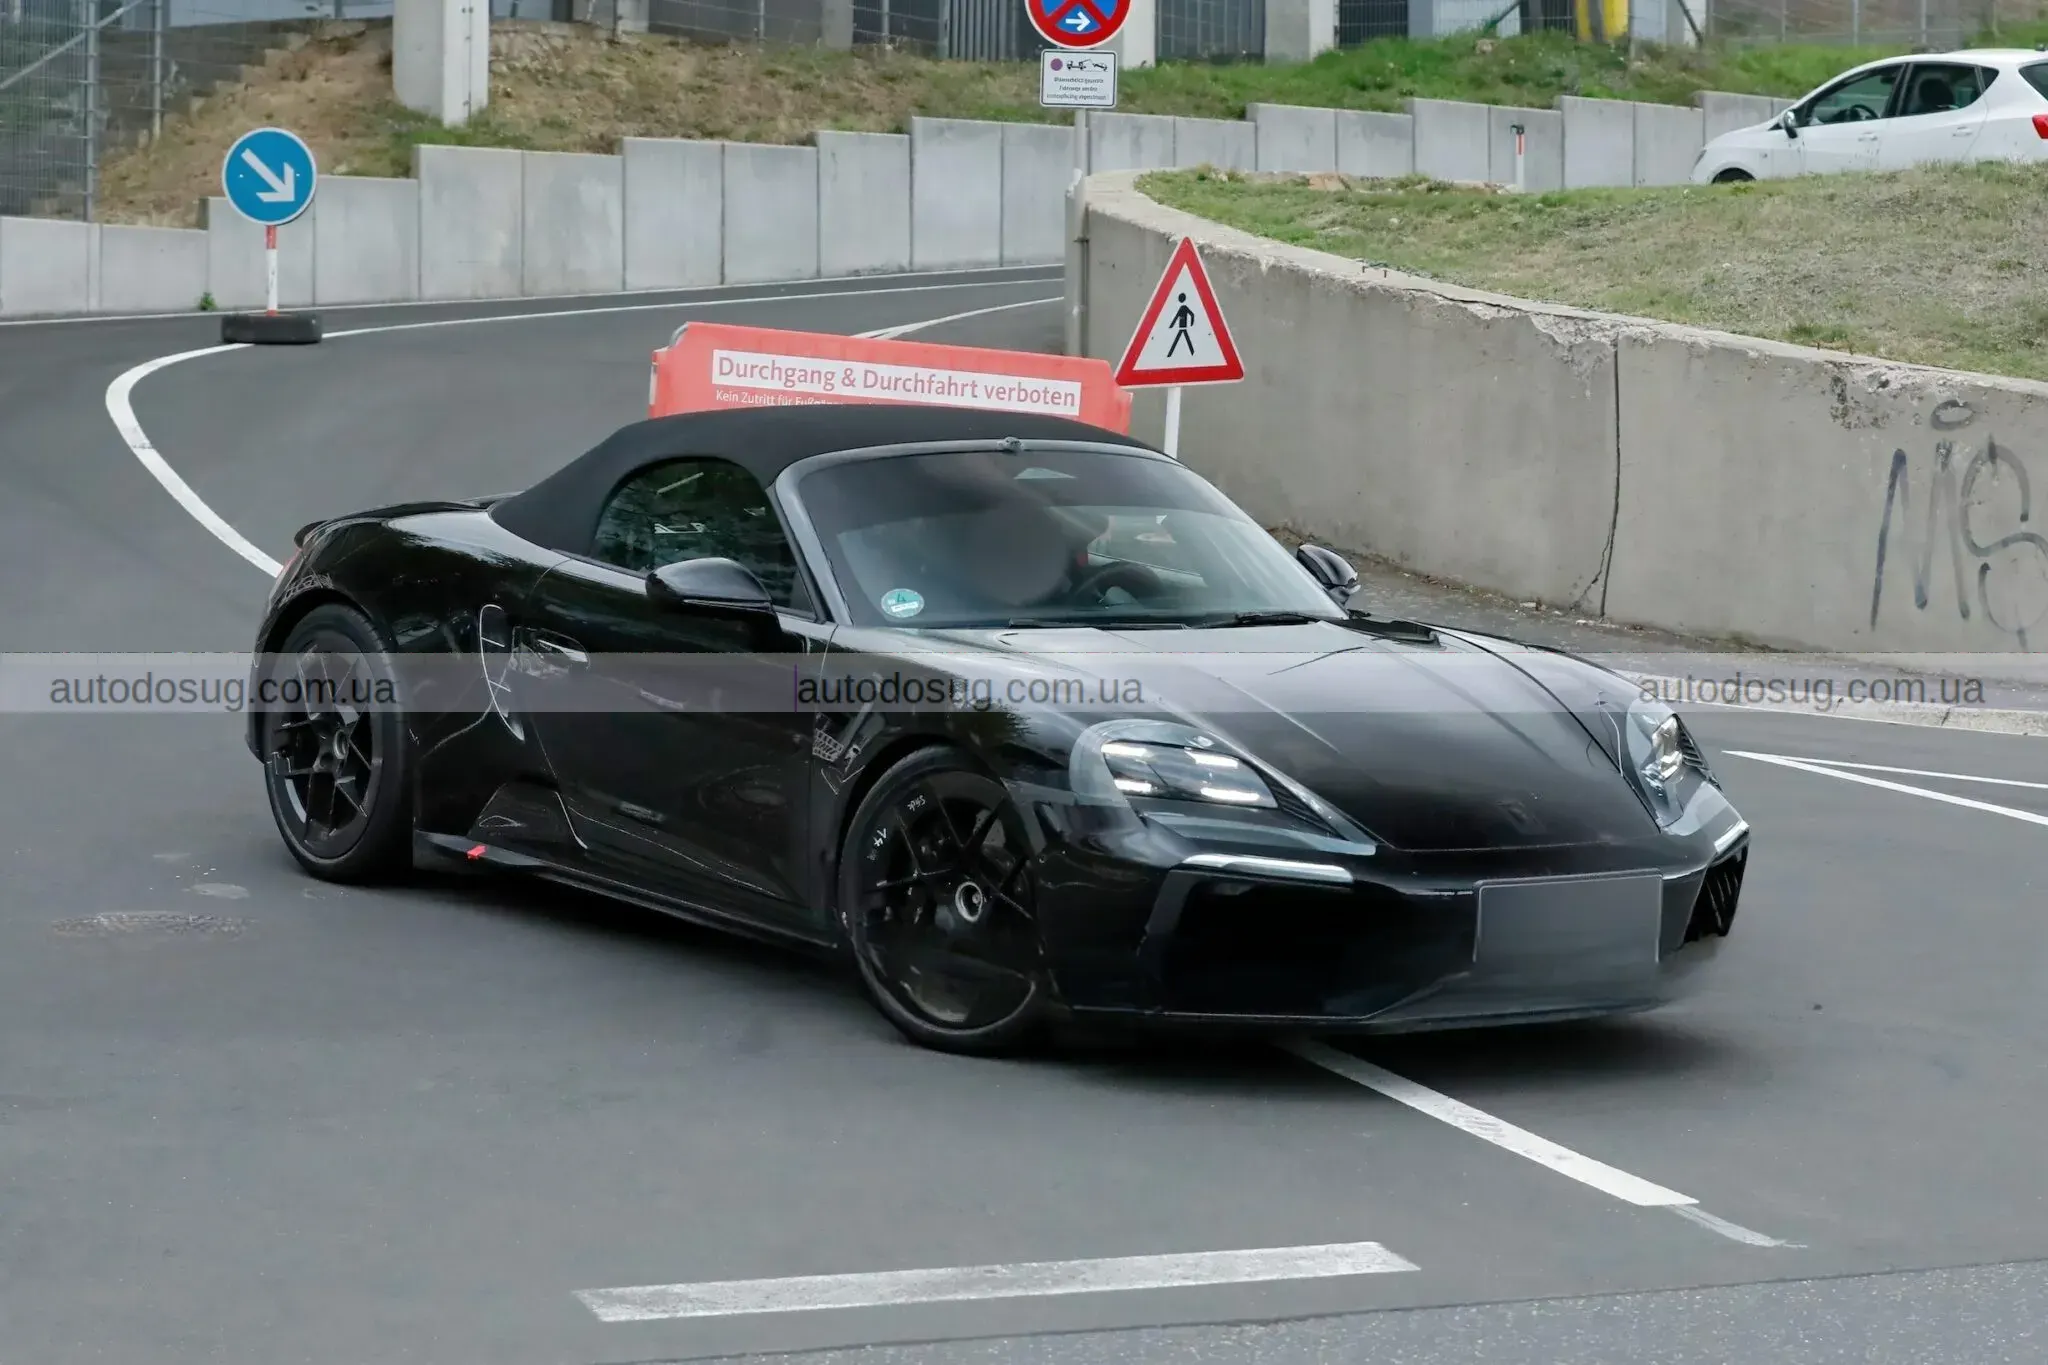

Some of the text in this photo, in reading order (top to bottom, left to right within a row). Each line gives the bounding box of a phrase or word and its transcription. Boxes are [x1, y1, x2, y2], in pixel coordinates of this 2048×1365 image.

[716, 389, 739, 402] Kein
[741, 392, 776, 405] Zutritt
[777, 393, 794, 405] für
[718, 356, 1076, 407] Durchgang & Durchfahrt verboten
